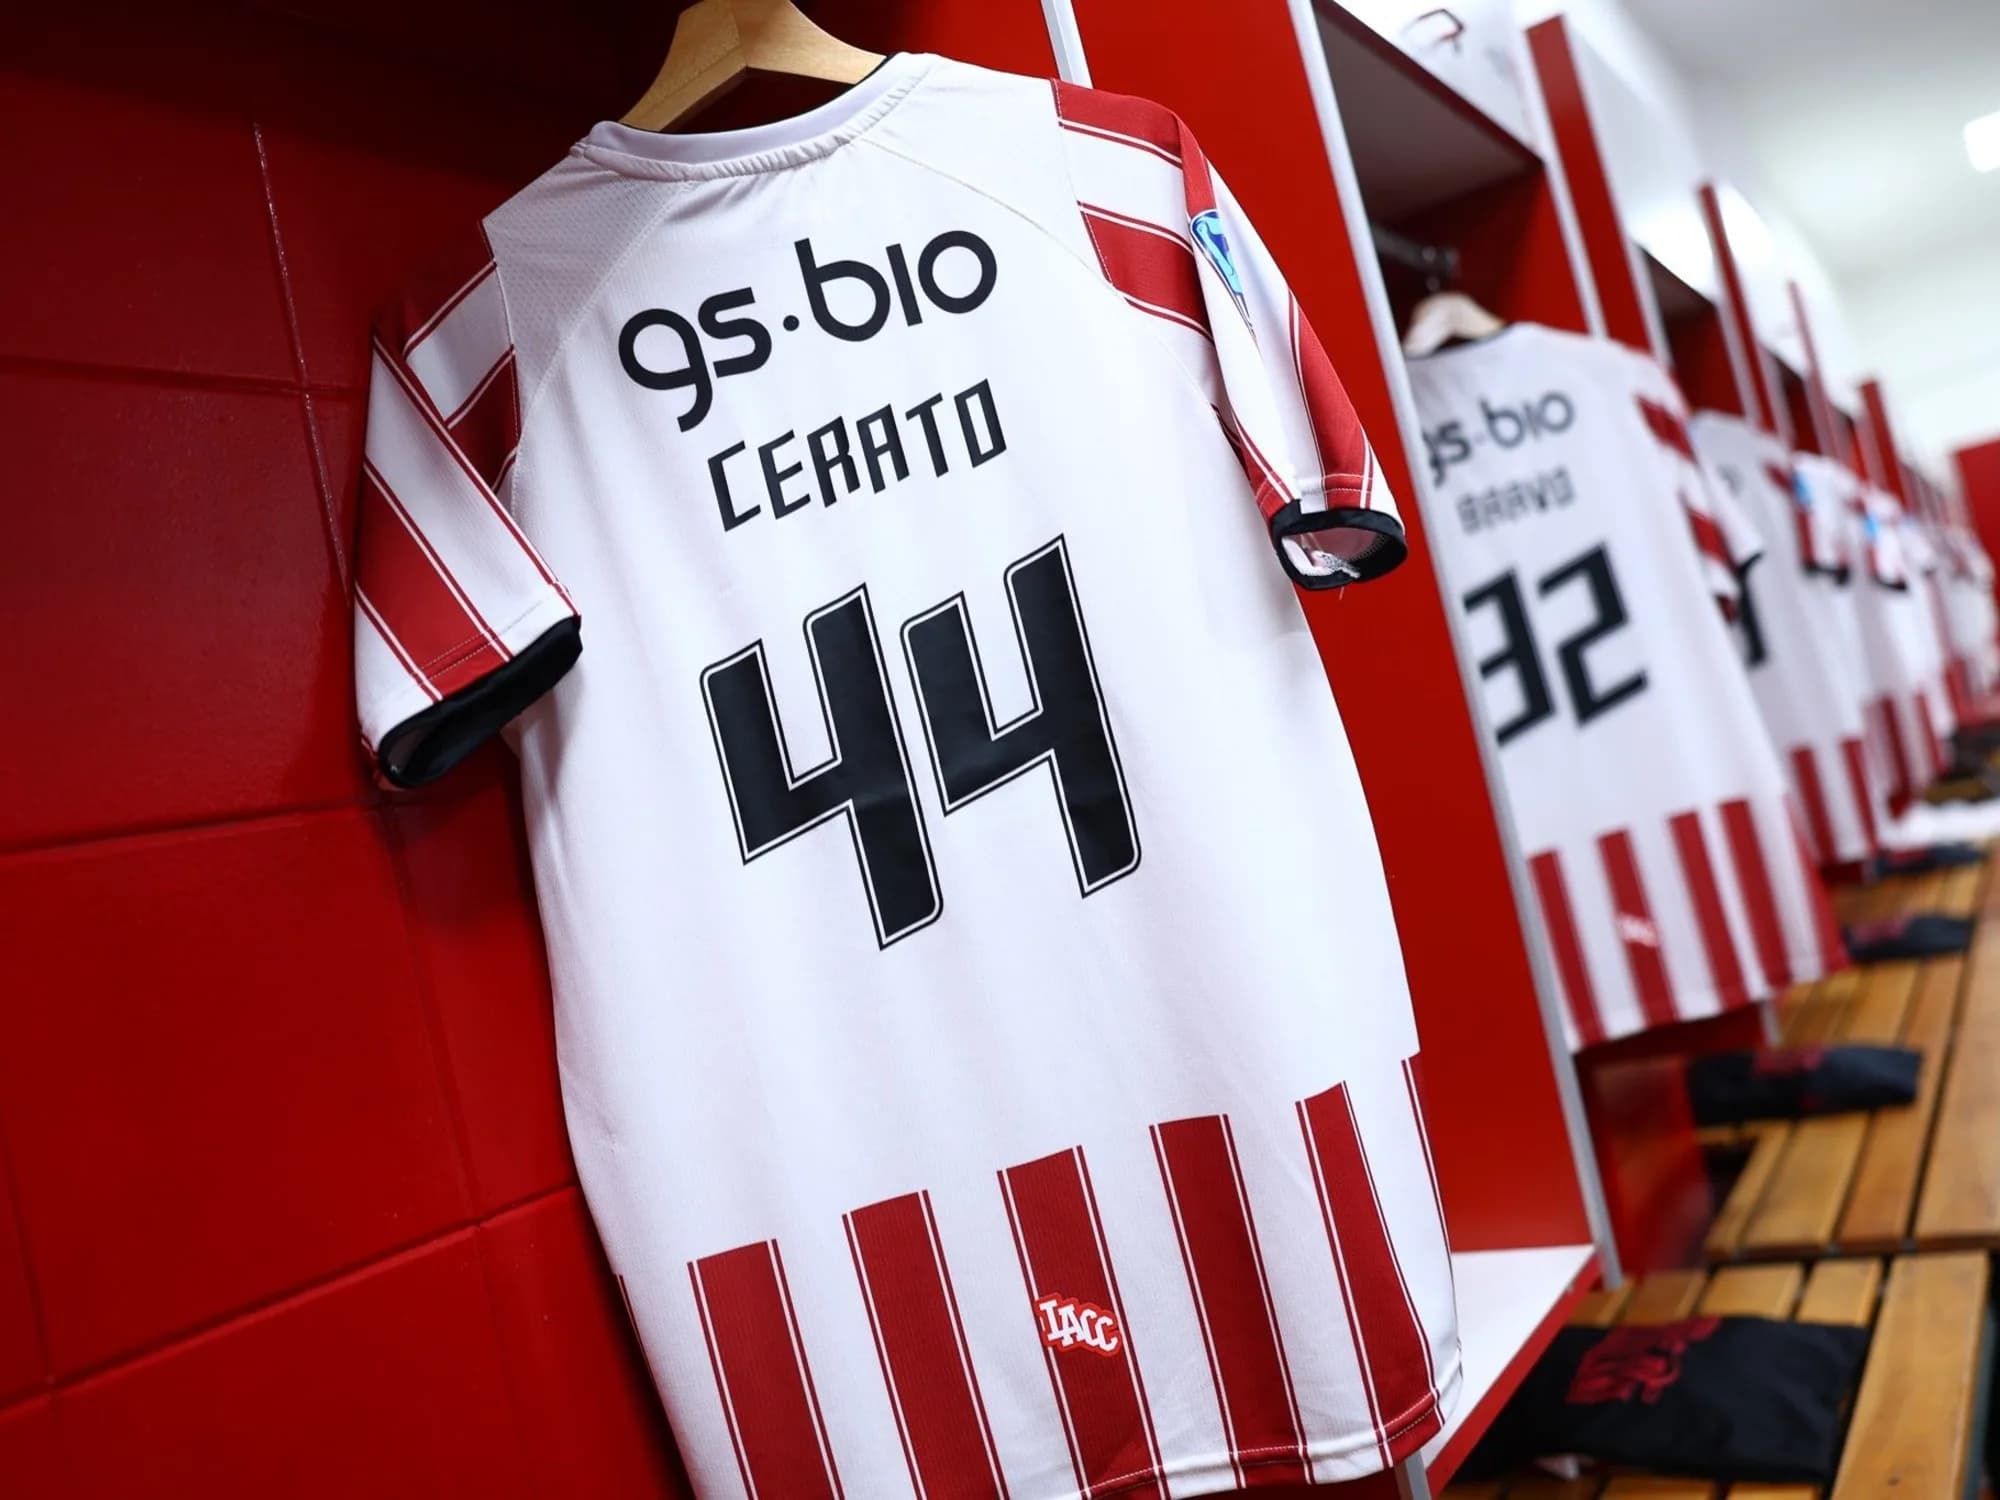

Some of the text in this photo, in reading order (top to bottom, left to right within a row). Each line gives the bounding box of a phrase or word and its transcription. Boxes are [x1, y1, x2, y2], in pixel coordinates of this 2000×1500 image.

[708, 379, 1007, 532] CERATO
[700, 534, 1142, 950] 44
[1462, 541, 1650, 748] 32
